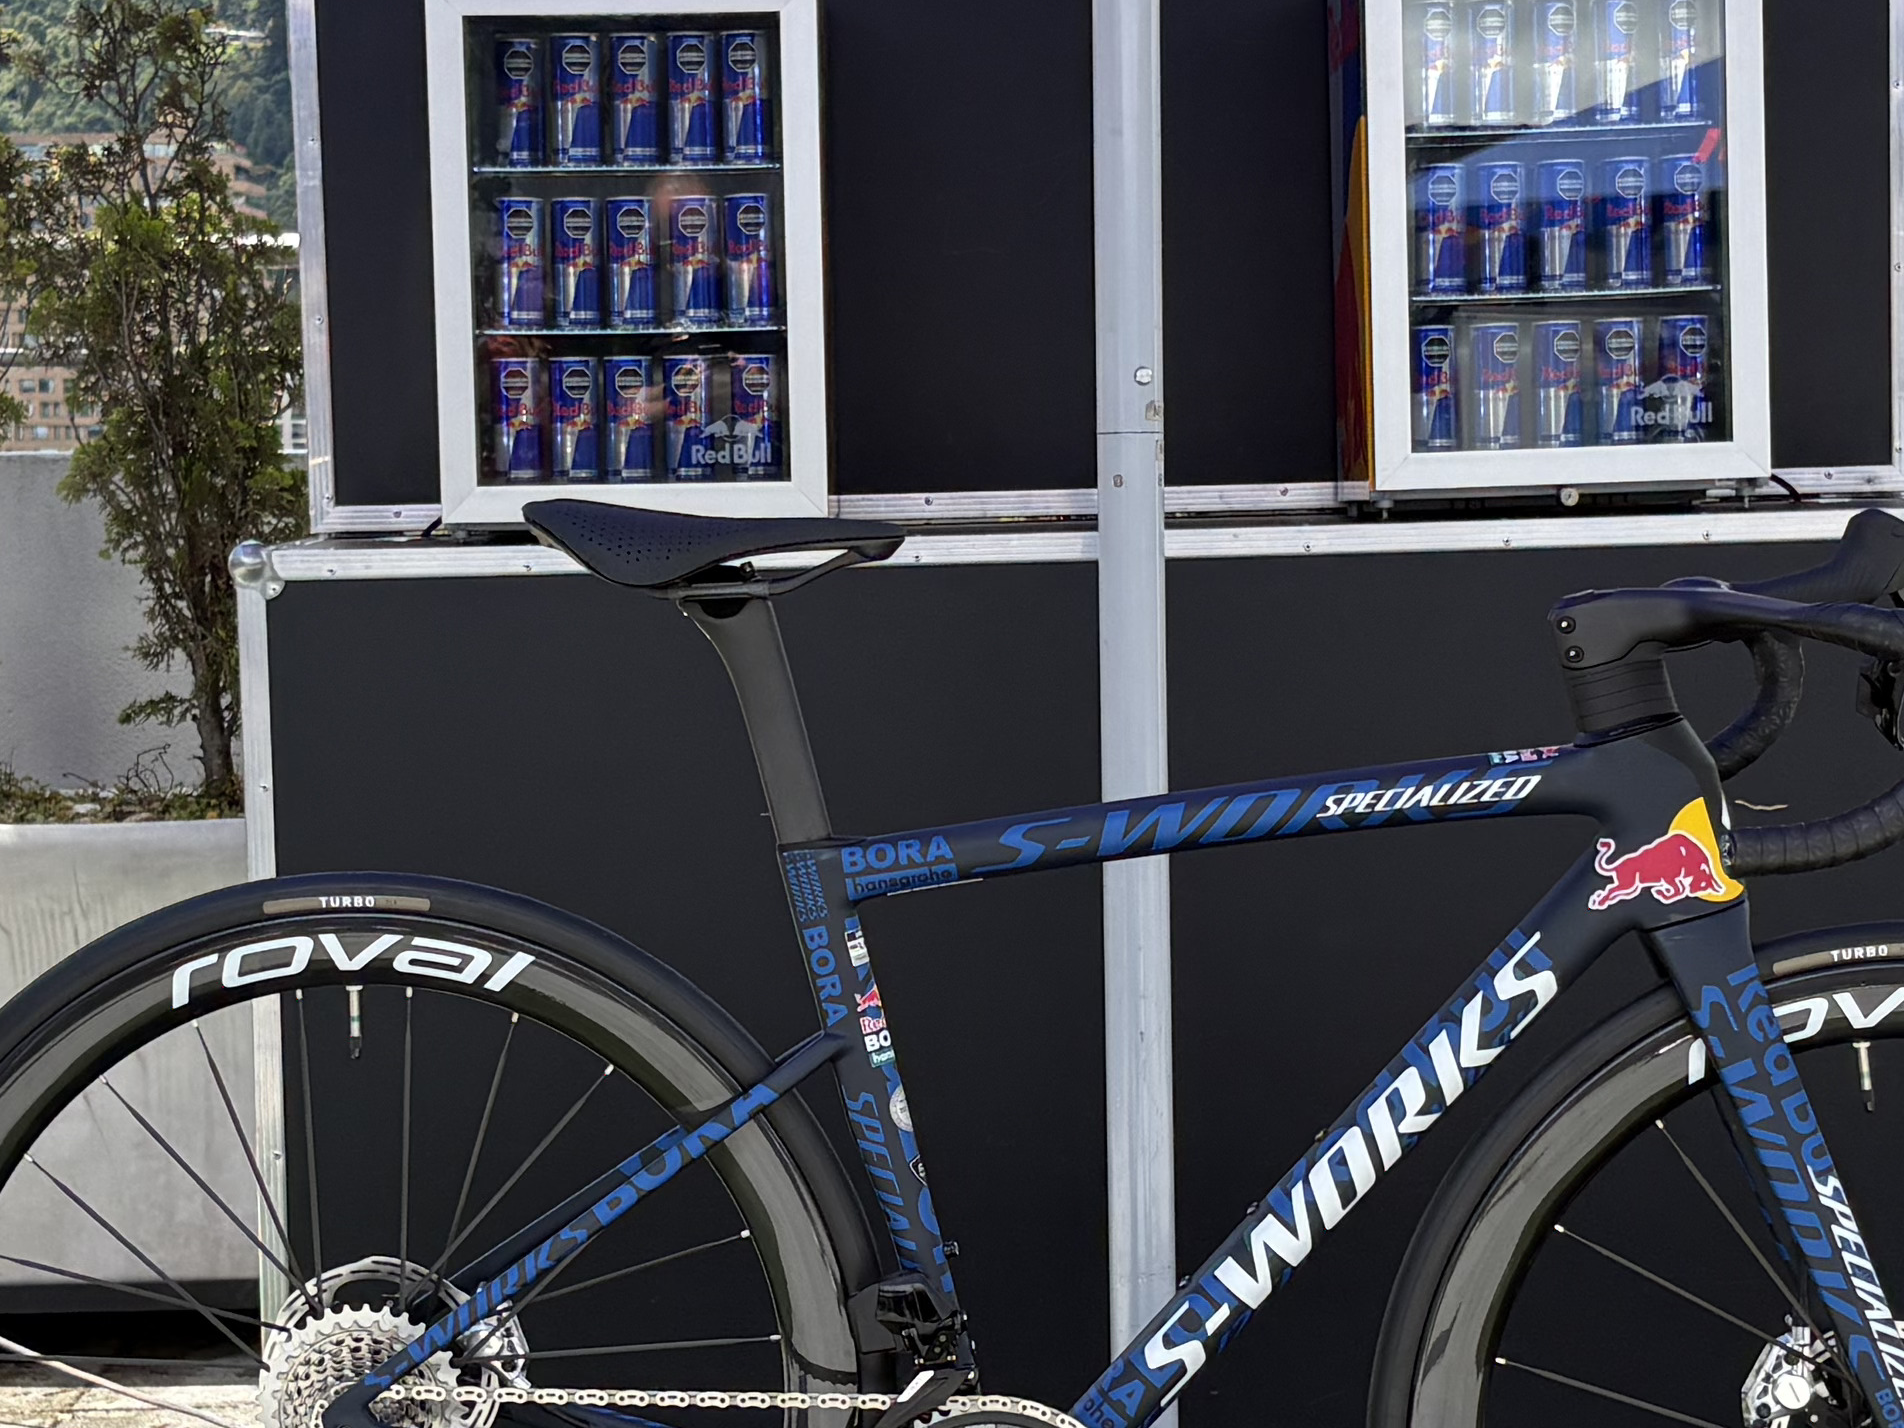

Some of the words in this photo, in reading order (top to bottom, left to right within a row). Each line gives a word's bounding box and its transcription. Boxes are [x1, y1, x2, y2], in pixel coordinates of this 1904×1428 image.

[690, 442, 731, 465] Red
[1317, 775, 1542, 818] SPECIALIZED
[840, 835, 954, 874] BORA
[318, 896, 375, 908] TURBO
[171, 933, 536, 1010] roval
[1830, 944, 1889, 963] TURBO
[802, 925, 849, 1027] BORA
[1144, 930, 1559, 1408] S-WORKS
